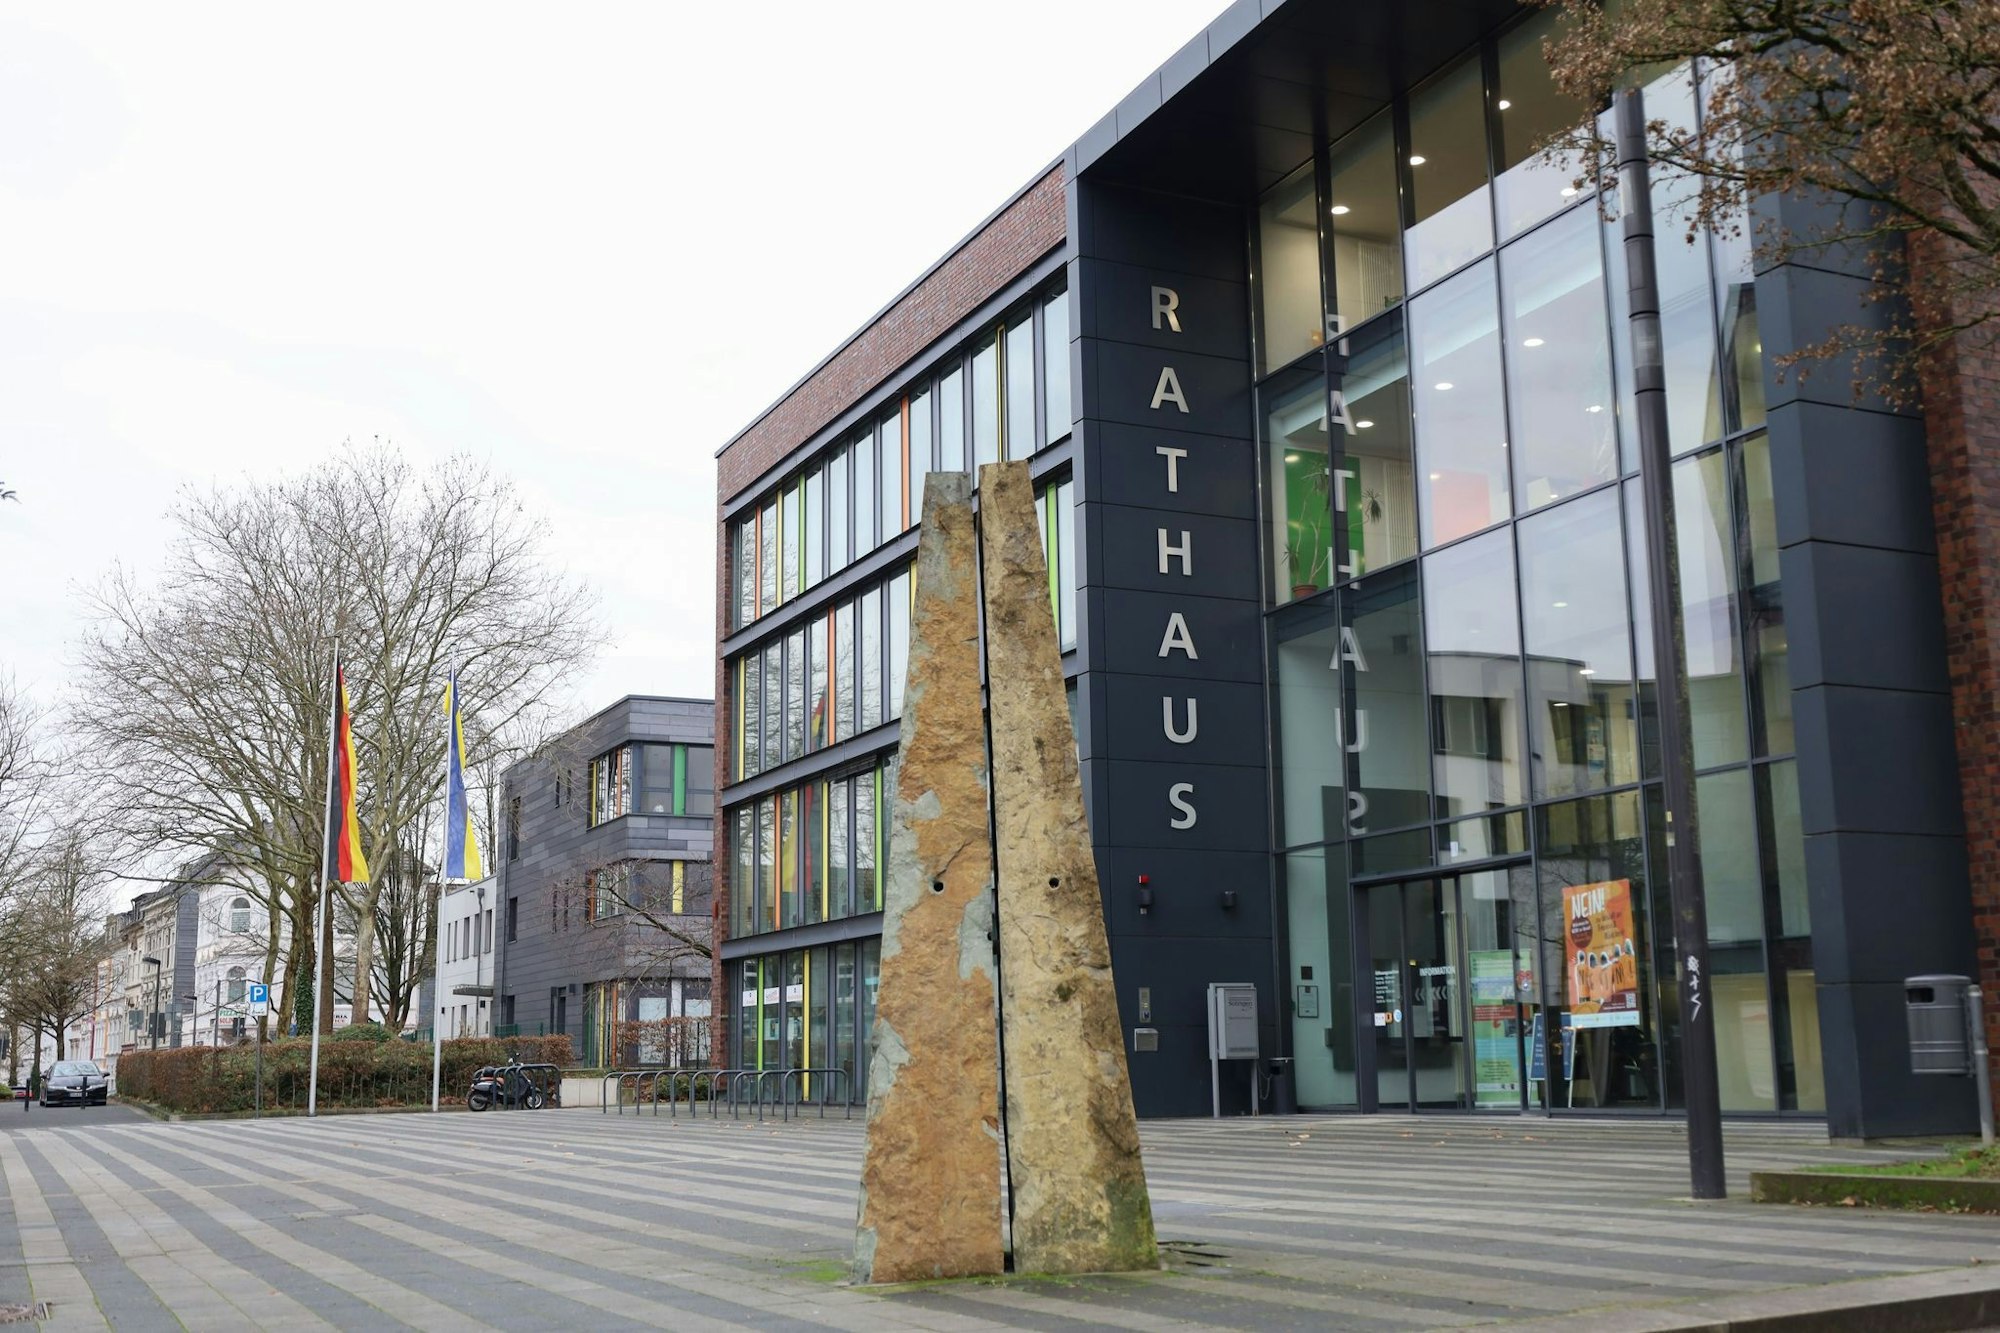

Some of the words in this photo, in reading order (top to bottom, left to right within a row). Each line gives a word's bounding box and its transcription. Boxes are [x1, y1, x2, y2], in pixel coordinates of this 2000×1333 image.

[1150, 285, 1199, 831] RATHAUS
[1571, 887, 1605, 920] NEIN!
[253, 986, 264, 1001] P
